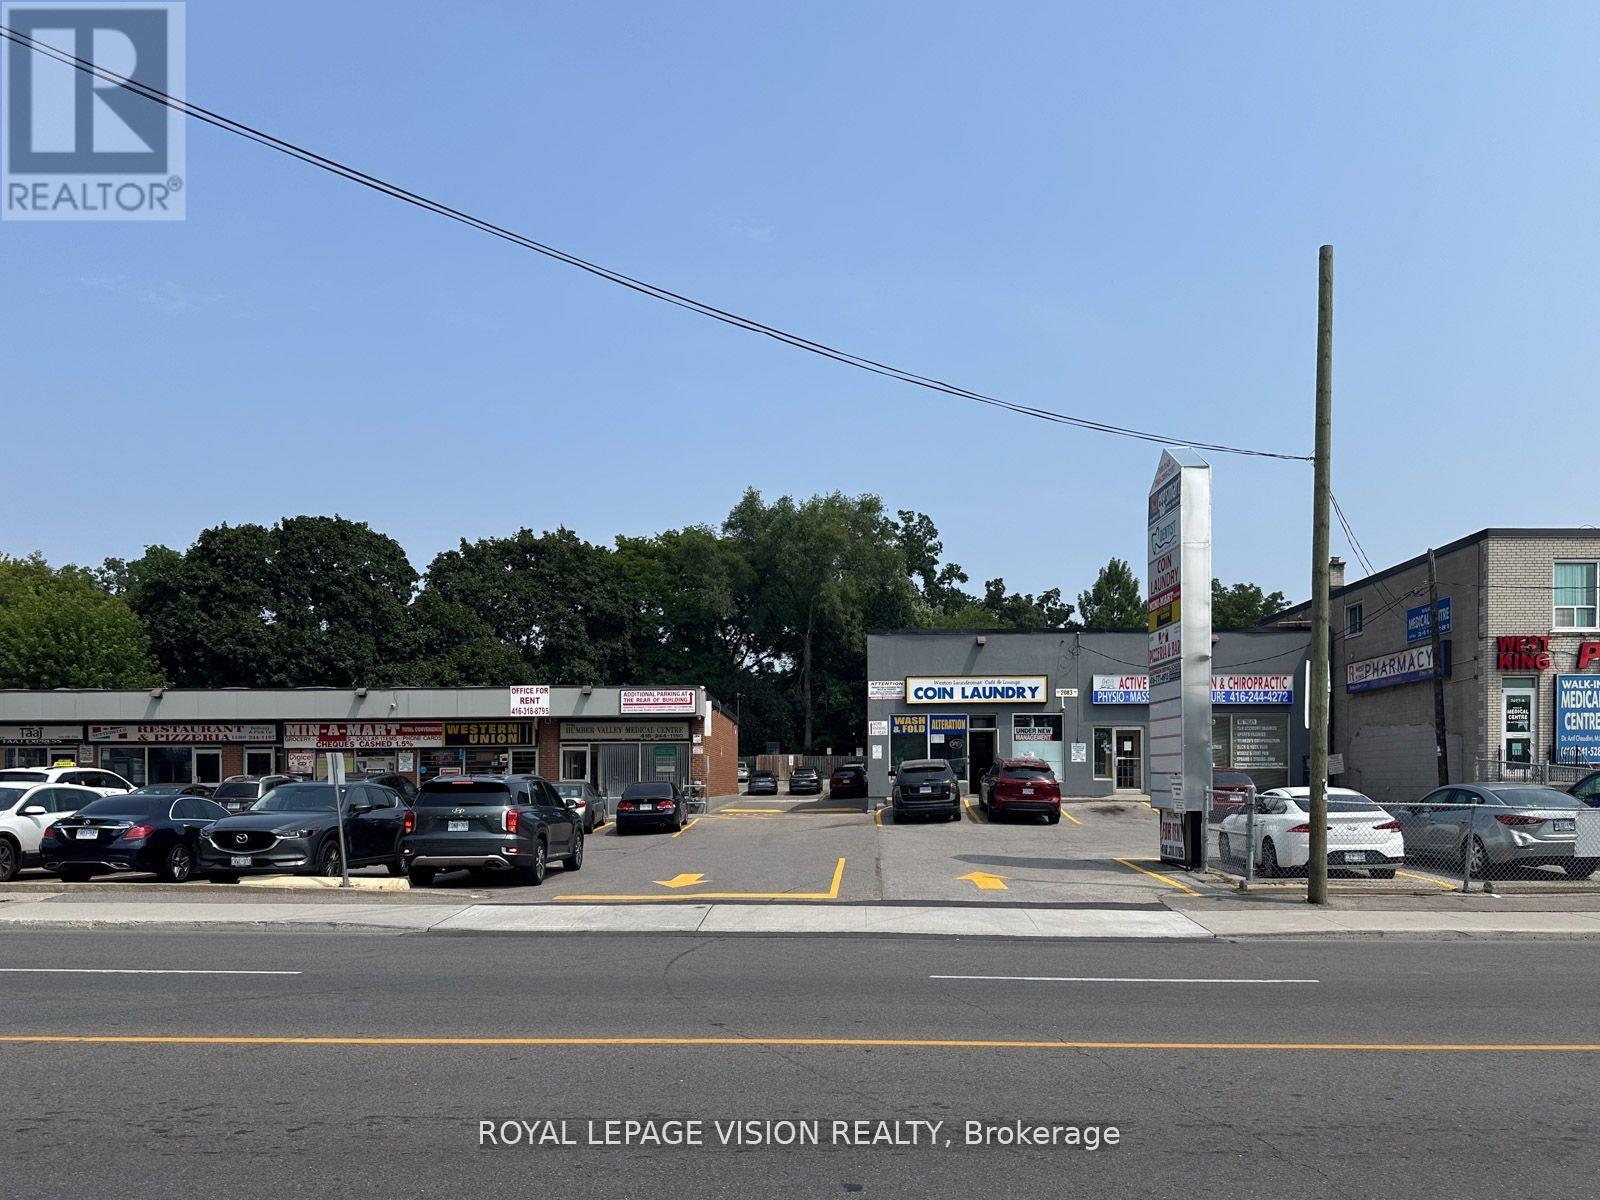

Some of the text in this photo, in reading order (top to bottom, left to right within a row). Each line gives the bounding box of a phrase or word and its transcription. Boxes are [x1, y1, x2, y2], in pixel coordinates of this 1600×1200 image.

[1157, 554, 1172, 574] COIN
[1150, 567, 1179, 595] LAUNDRY
[1497, 636, 1550, 653] WEST
[1364, 649, 1433, 678] PHARMACY
[1497, 653, 1550, 671] KING
[1119, 677, 1147, 690] ACTIVE
[1220, 677, 1226, 690] &
[1228, 677, 1288, 690] CHIROPRACTIC
[511, 687, 549, 695] OFFICE FOR
[913, 686, 1040, 700] COIN LAUNDRY
[1097, 691, 1125, 702] PHYSIO
[1230, 691, 1288, 703] 416-244-4272
[519, 697, 541, 705] RENT
[1561, 690, 1600, 709] MEDICA
[894, 716, 926, 725] WASH
[931, 719, 966, 730] ALTERATION
[1564, 712, 1600, 731] CENTRE
[19, 726, 44, 739] Taaj
[137, 725, 245, 734] RESTAURANT
[285, 723, 400, 736] MIN-A-MART
[446, 723, 518, 735] WESTERN
[893, 725, 926, 733] & FOLD
[315, 740, 355, 748] CHEQUES
[359, 740, 393, 748] CASHED
[469, 734, 518, 744] UNION
